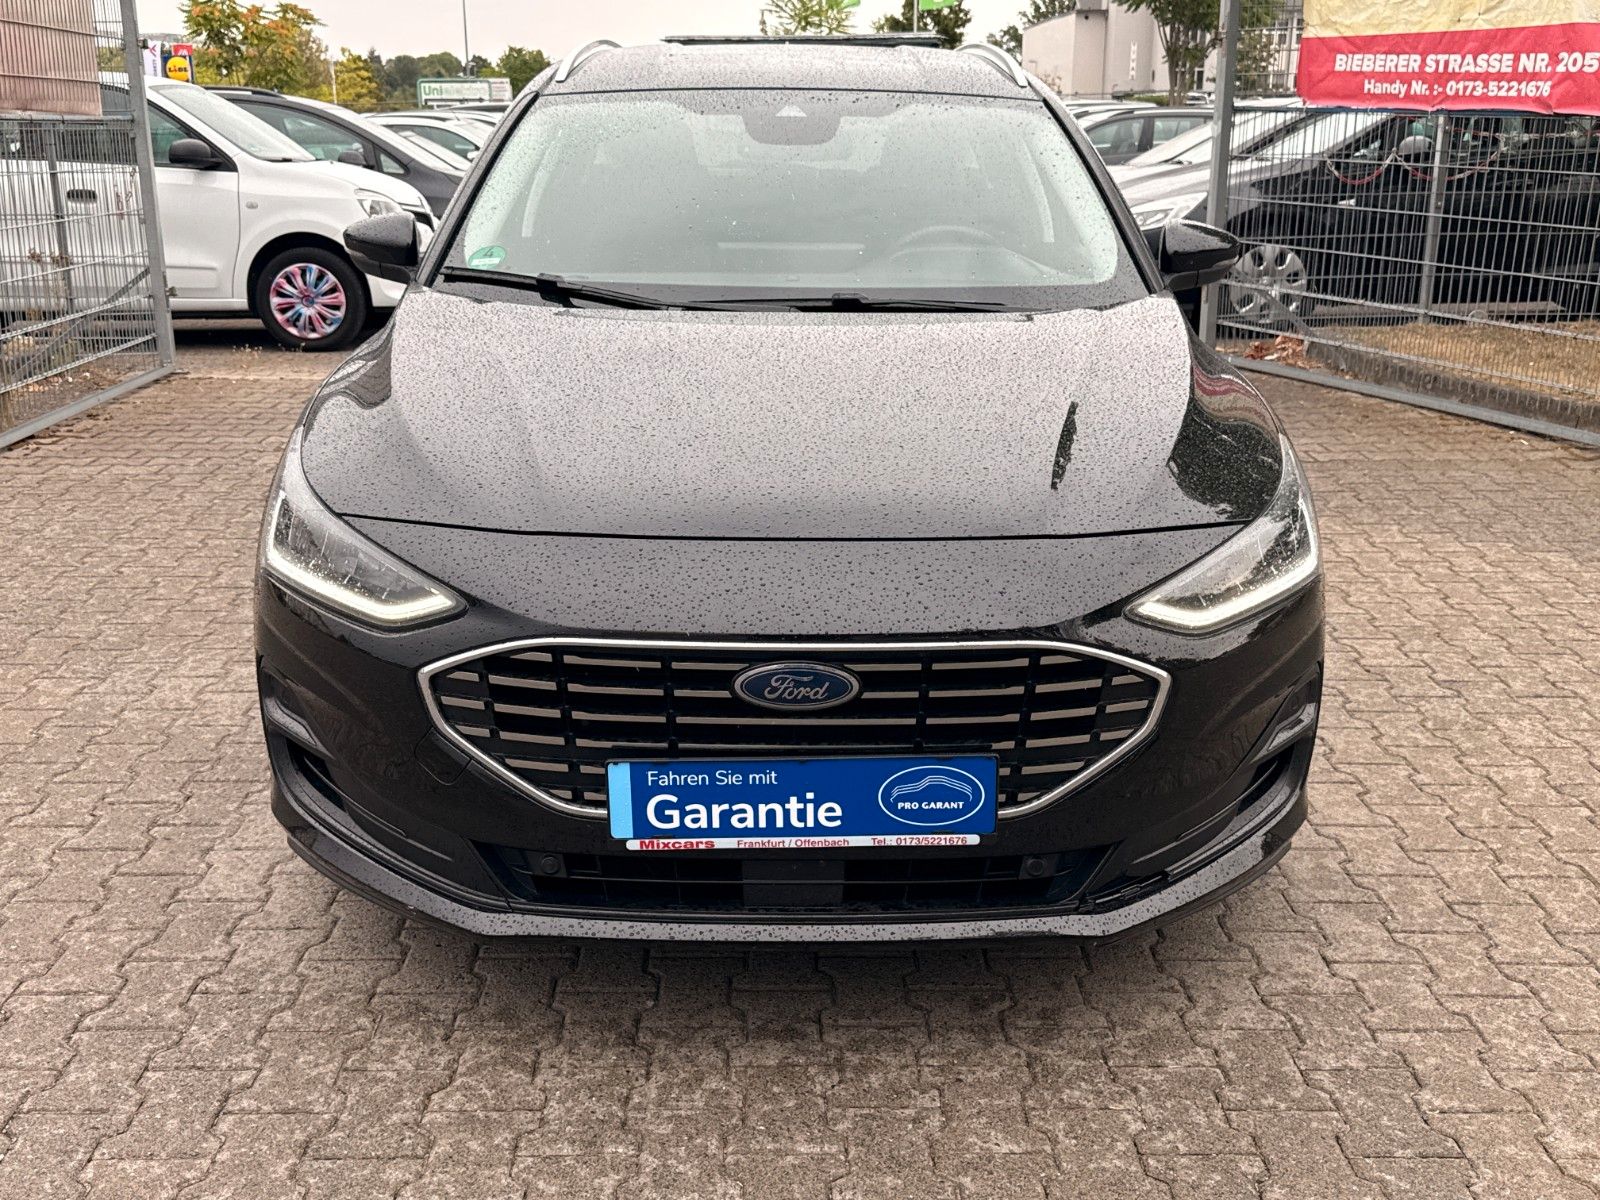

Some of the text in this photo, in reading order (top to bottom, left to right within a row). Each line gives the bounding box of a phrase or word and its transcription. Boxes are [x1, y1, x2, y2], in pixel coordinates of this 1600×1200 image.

[1334, 51, 1600, 73] BIEBERER STRASSE NR. 205
[1363, 79, 1407, 98] Handy
[1410, 80, 1429, 95] Nr.
[764, 674, 830, 700] Ford
[647, 770, 778, 786] Fahren Sie mit
[646, 793, 842, 829] Garantie
[898, 801, 965, 810] PRO GARANT
[639, 840, 715, 850] Mixcars
[737, 838, 784, 848] Frankfurt
[795, 838, 849, 847] Offenbach
[896, 836, 967, 846] 0173/5221676
